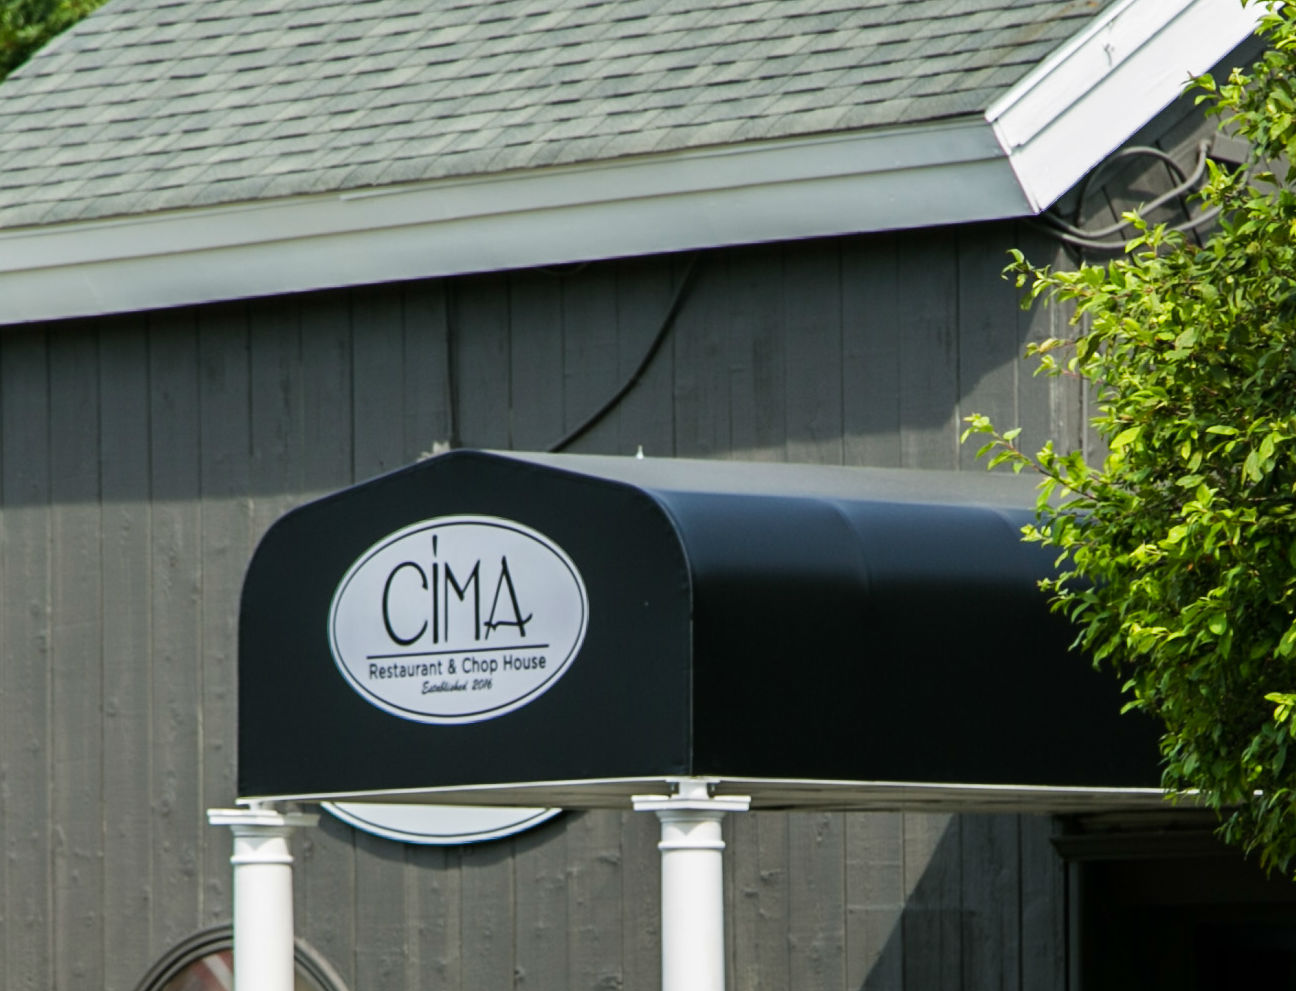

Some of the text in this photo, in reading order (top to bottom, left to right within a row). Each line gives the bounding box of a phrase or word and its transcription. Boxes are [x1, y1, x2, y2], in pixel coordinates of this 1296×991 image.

[369, 655, 547, 680] Restaurant & Chop House
[421, 680, 468, 695] Established
